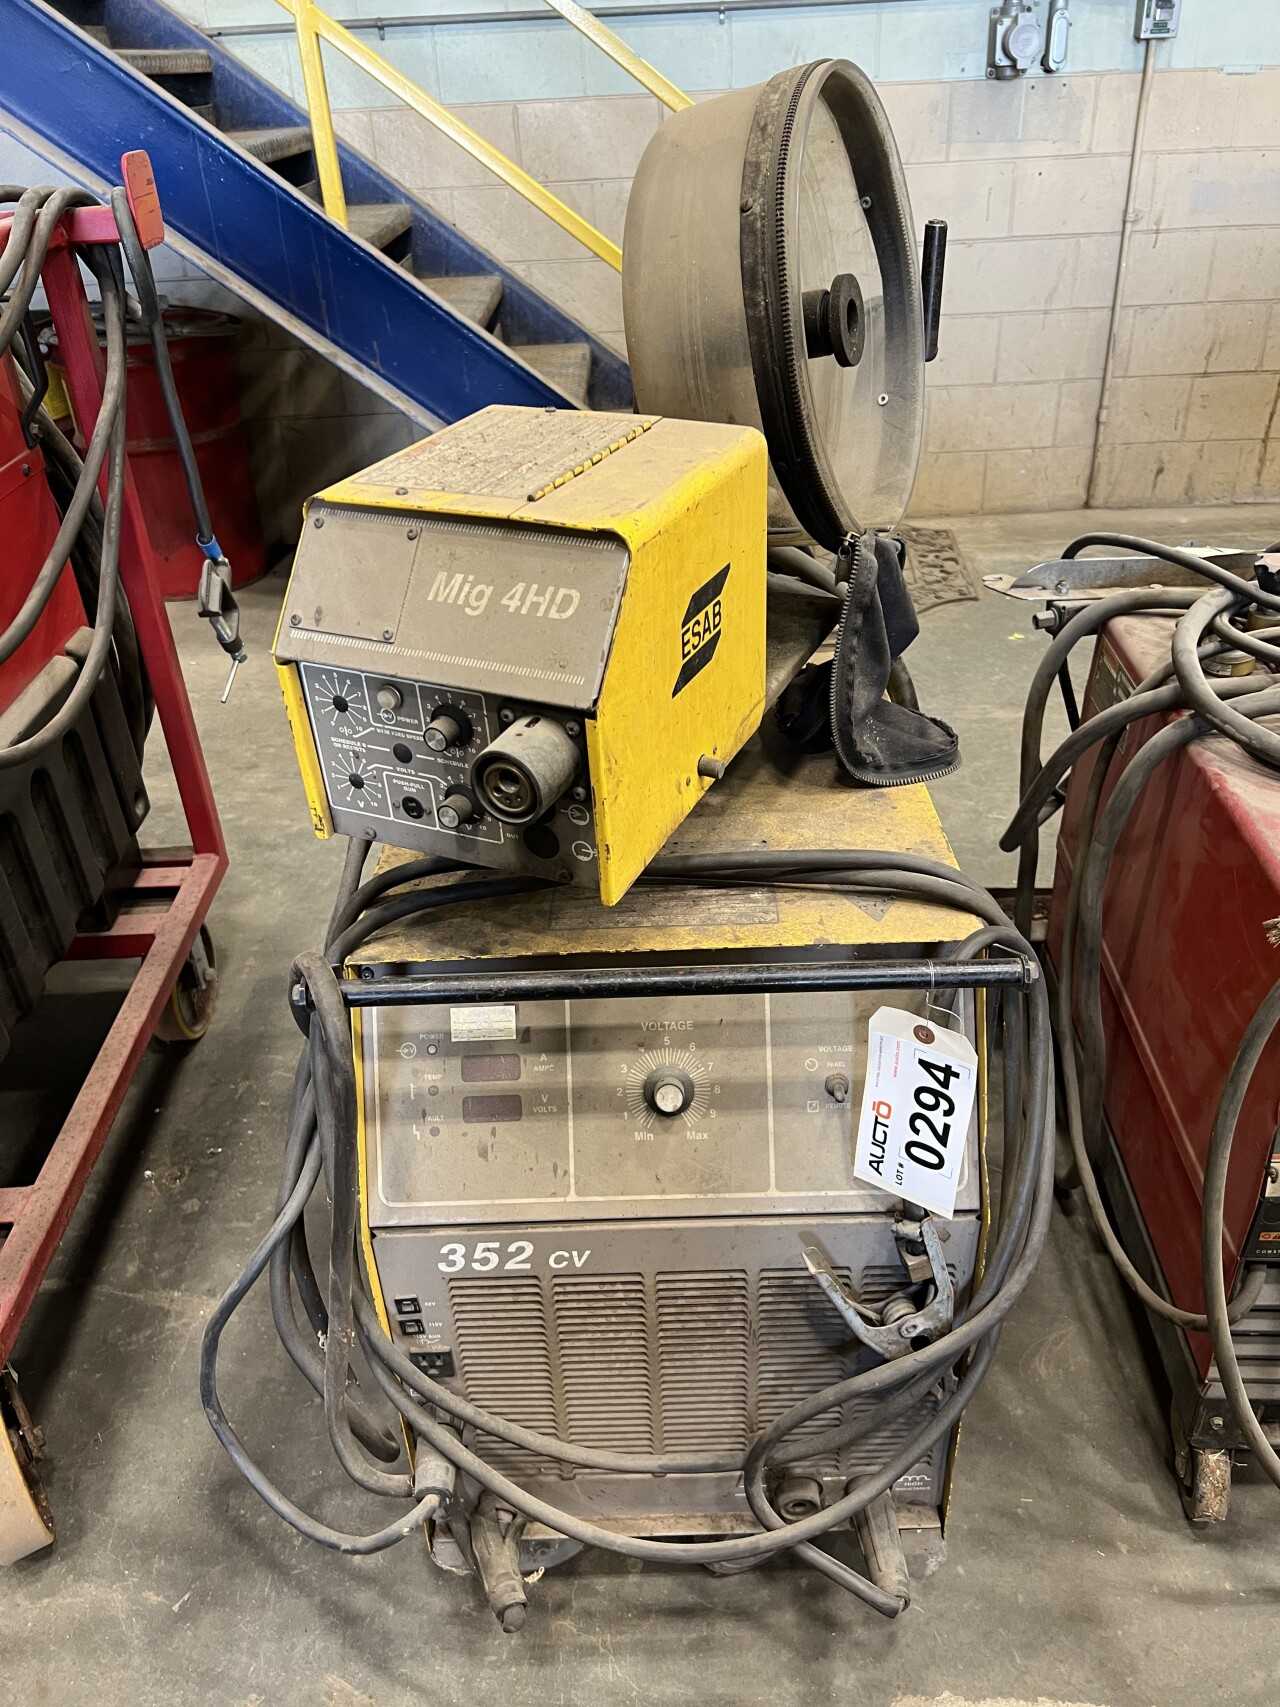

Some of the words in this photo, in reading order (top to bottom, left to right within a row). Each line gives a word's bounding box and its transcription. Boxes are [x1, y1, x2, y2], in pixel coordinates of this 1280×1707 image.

[427, 571, 494, 617] Mig
[501, 582, 580, 620] 4HD
[681, 599, 722, 660] ESAB
[641, 1020, 694, 1032] VOLTAGE
[664, 1036, 671, 1046] 5
[690, 1042, 697, 1052] 6
[817, 1044, 854, 1053] VOLTAGE
[620, 1063, 628, 1073] 3
[707, 1062, 714, 1071] 7
[616, 1088, 624, 1097] 2
[541, 1094, 549, 1103] V
[532, 1105, 558, 1114] VOLTS
[709, 1108, 717, 1118] 9
[904, 1057, 961, 1171] 0294
[686, 1131, 709, 1141] Max
[895, 1169, 904, 1186] LOT
[437, 1240, 535, 1273] 352
